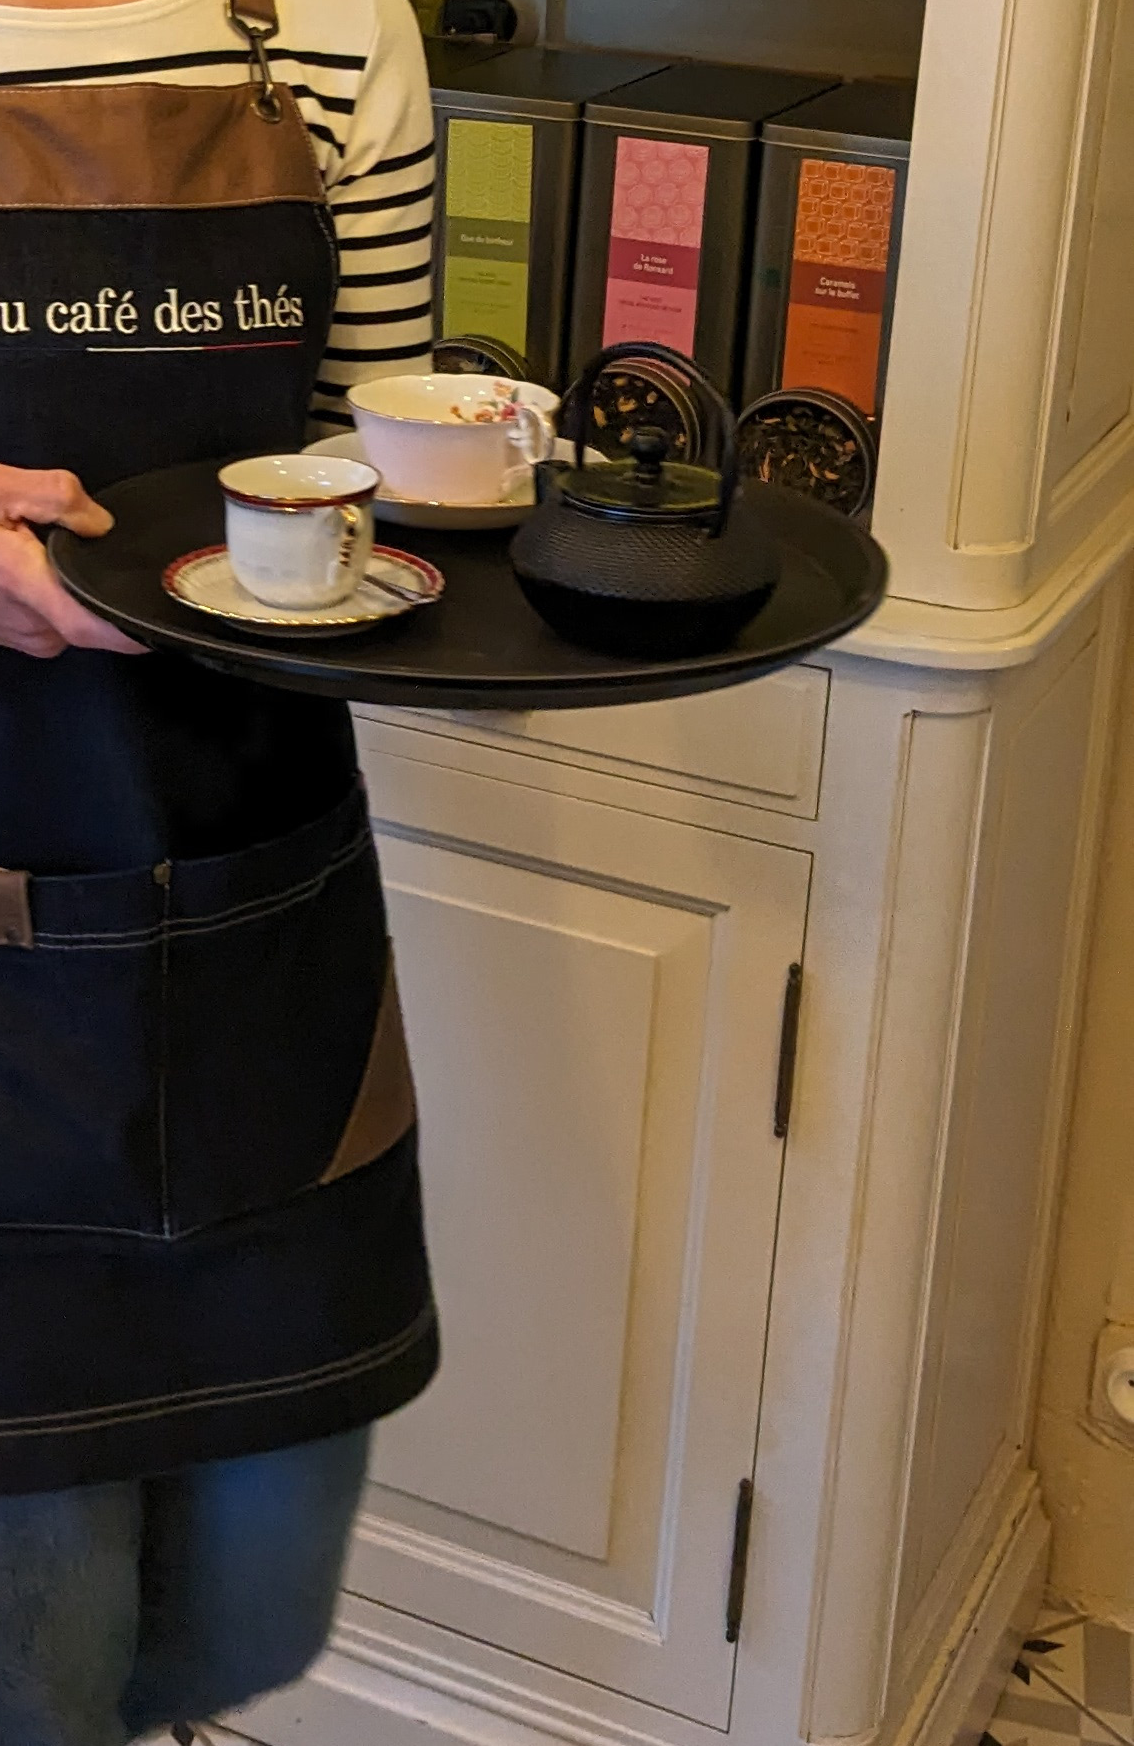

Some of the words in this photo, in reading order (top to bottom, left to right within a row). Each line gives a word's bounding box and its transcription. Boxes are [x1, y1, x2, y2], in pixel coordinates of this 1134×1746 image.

[46, 286, 139, 334] café
[154, 288, 224, 334] des
[234, 284, 304, 331] thés
